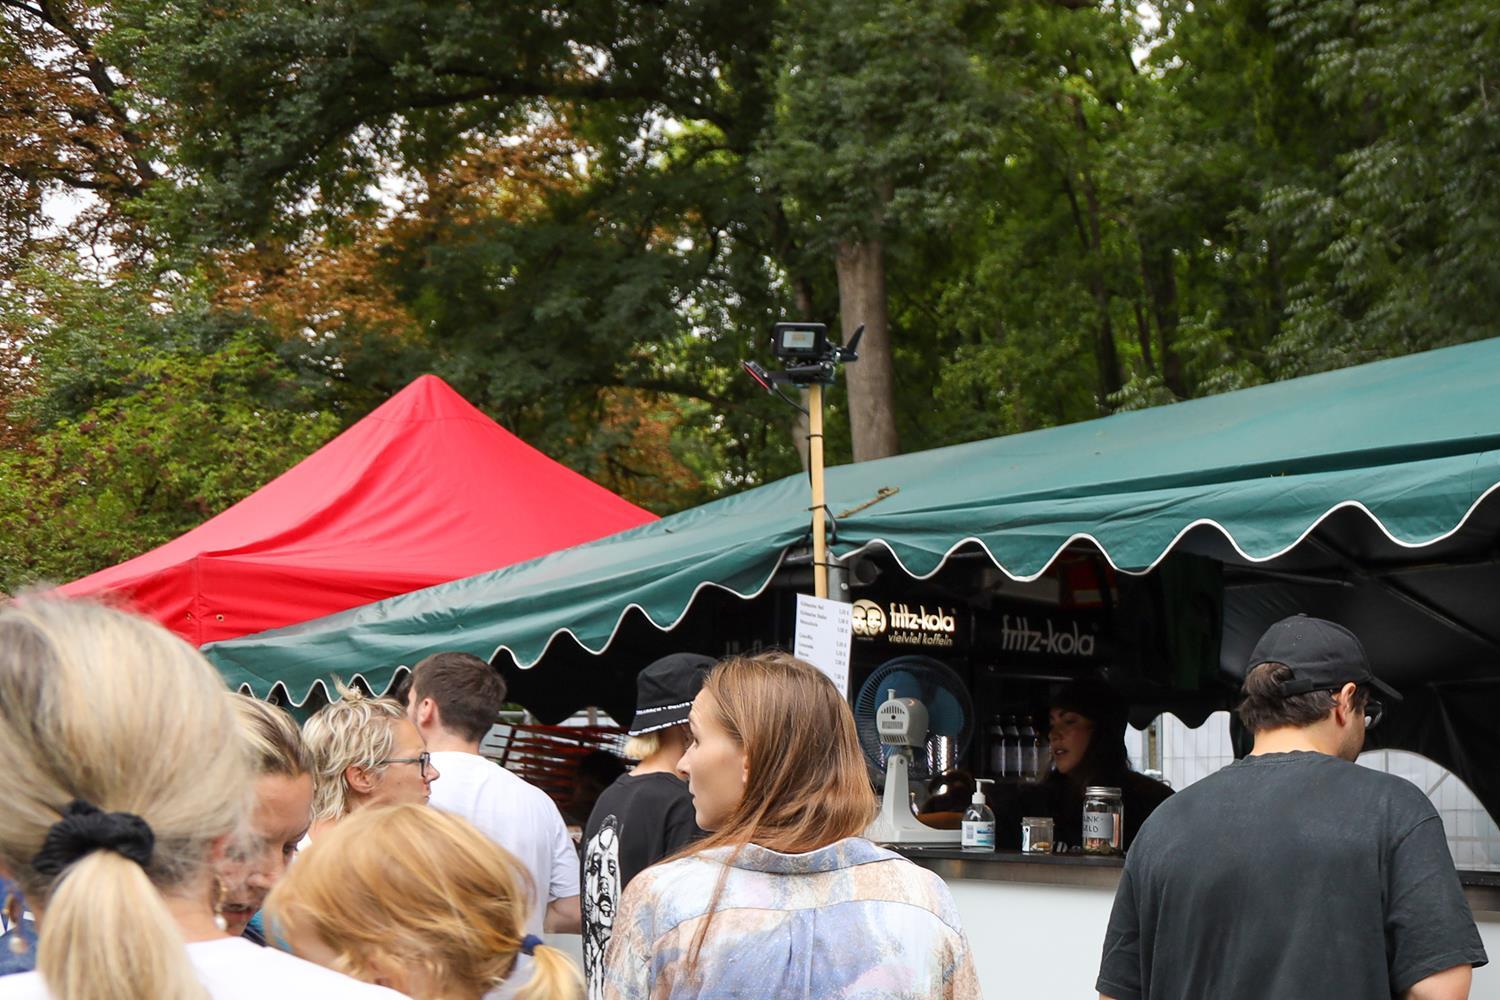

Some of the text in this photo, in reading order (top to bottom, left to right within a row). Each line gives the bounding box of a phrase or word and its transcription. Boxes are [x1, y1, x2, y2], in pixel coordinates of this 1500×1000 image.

[889, 602, 955, 632] fritz-kola
[888, 630, 953, 646] vielviel koffein
[1001, 614, 1094, 656] fritz-kola
